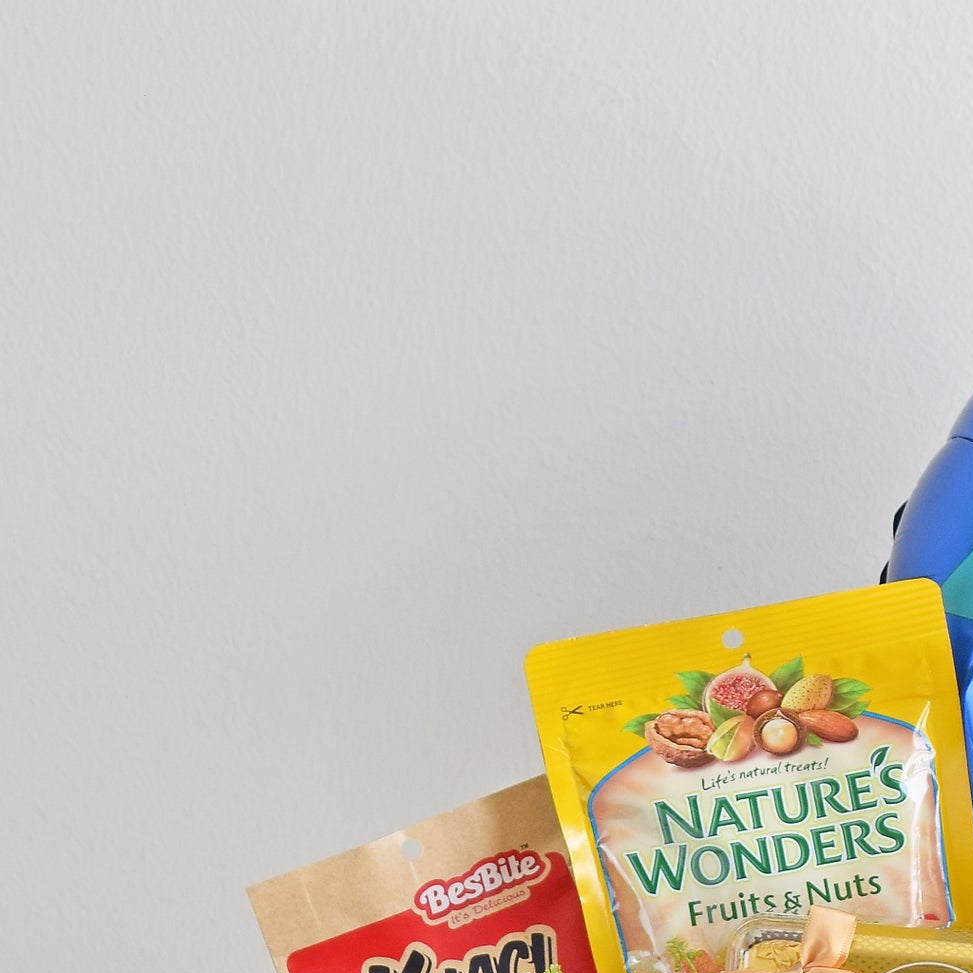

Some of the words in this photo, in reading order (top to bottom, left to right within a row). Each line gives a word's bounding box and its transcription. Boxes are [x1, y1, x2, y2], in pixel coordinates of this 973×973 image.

[588, 703, 605, 711] TEAR
[605, 699, 623, 708] HERE
[653, 745, 909, 845] NATURE'S
[701, 770, 736, 791] Life's
[739, 762, 782, 780] natural
[784, 757, 829, 773] treats!
[626, 811, 906, 896] WONDERS
[420, 855, 540, 915] BesBite
[450, 911, 470, 925] It's
[472, 888, 526, 915] Delicious
[688, 892, 777, 927] Fruits
[784, 890, 802, 911] &
[806, 873, 882, 906] Nuts
